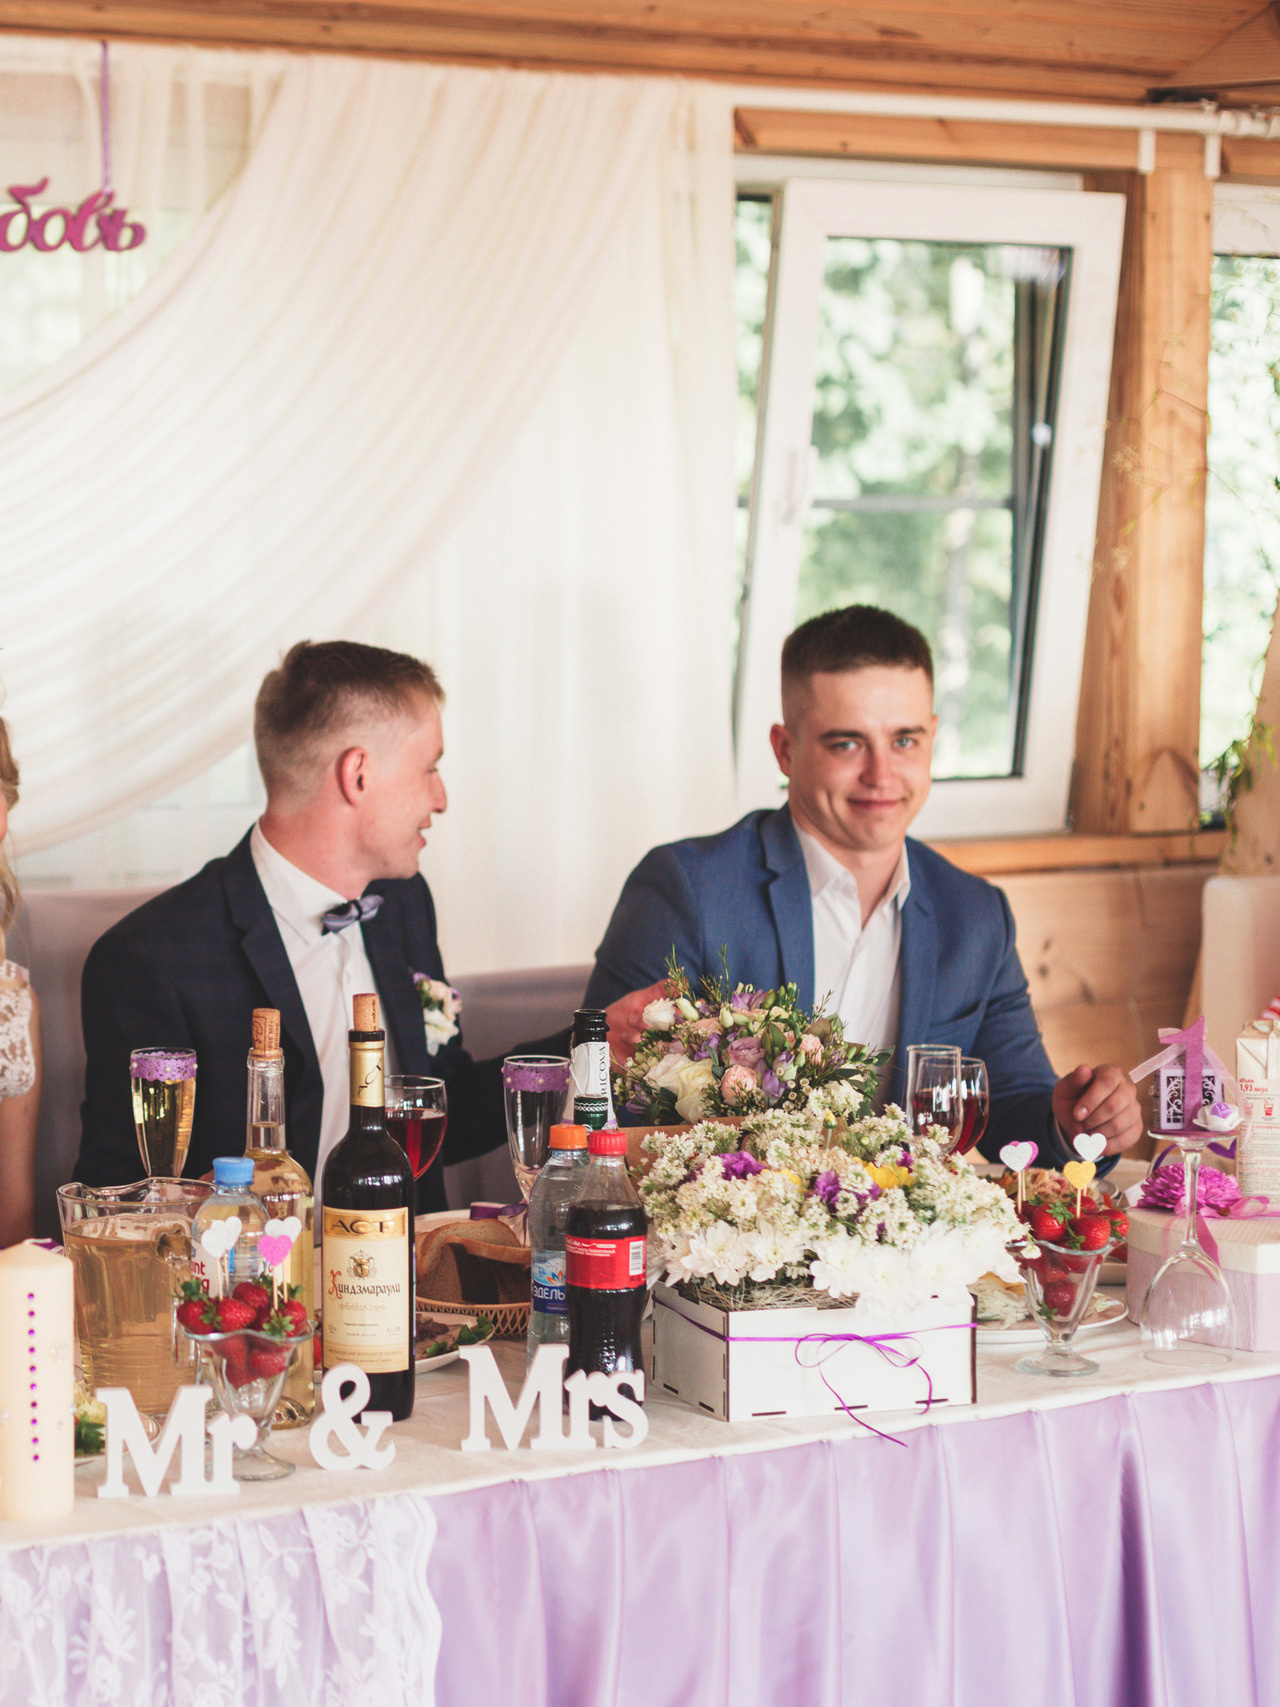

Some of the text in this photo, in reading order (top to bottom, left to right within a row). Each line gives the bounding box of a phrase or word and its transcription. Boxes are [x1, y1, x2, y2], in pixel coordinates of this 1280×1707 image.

[328, 1269, 401, 1299] Киндзмараули
[97, 1344, 649, 1499] Mr & Mrs
